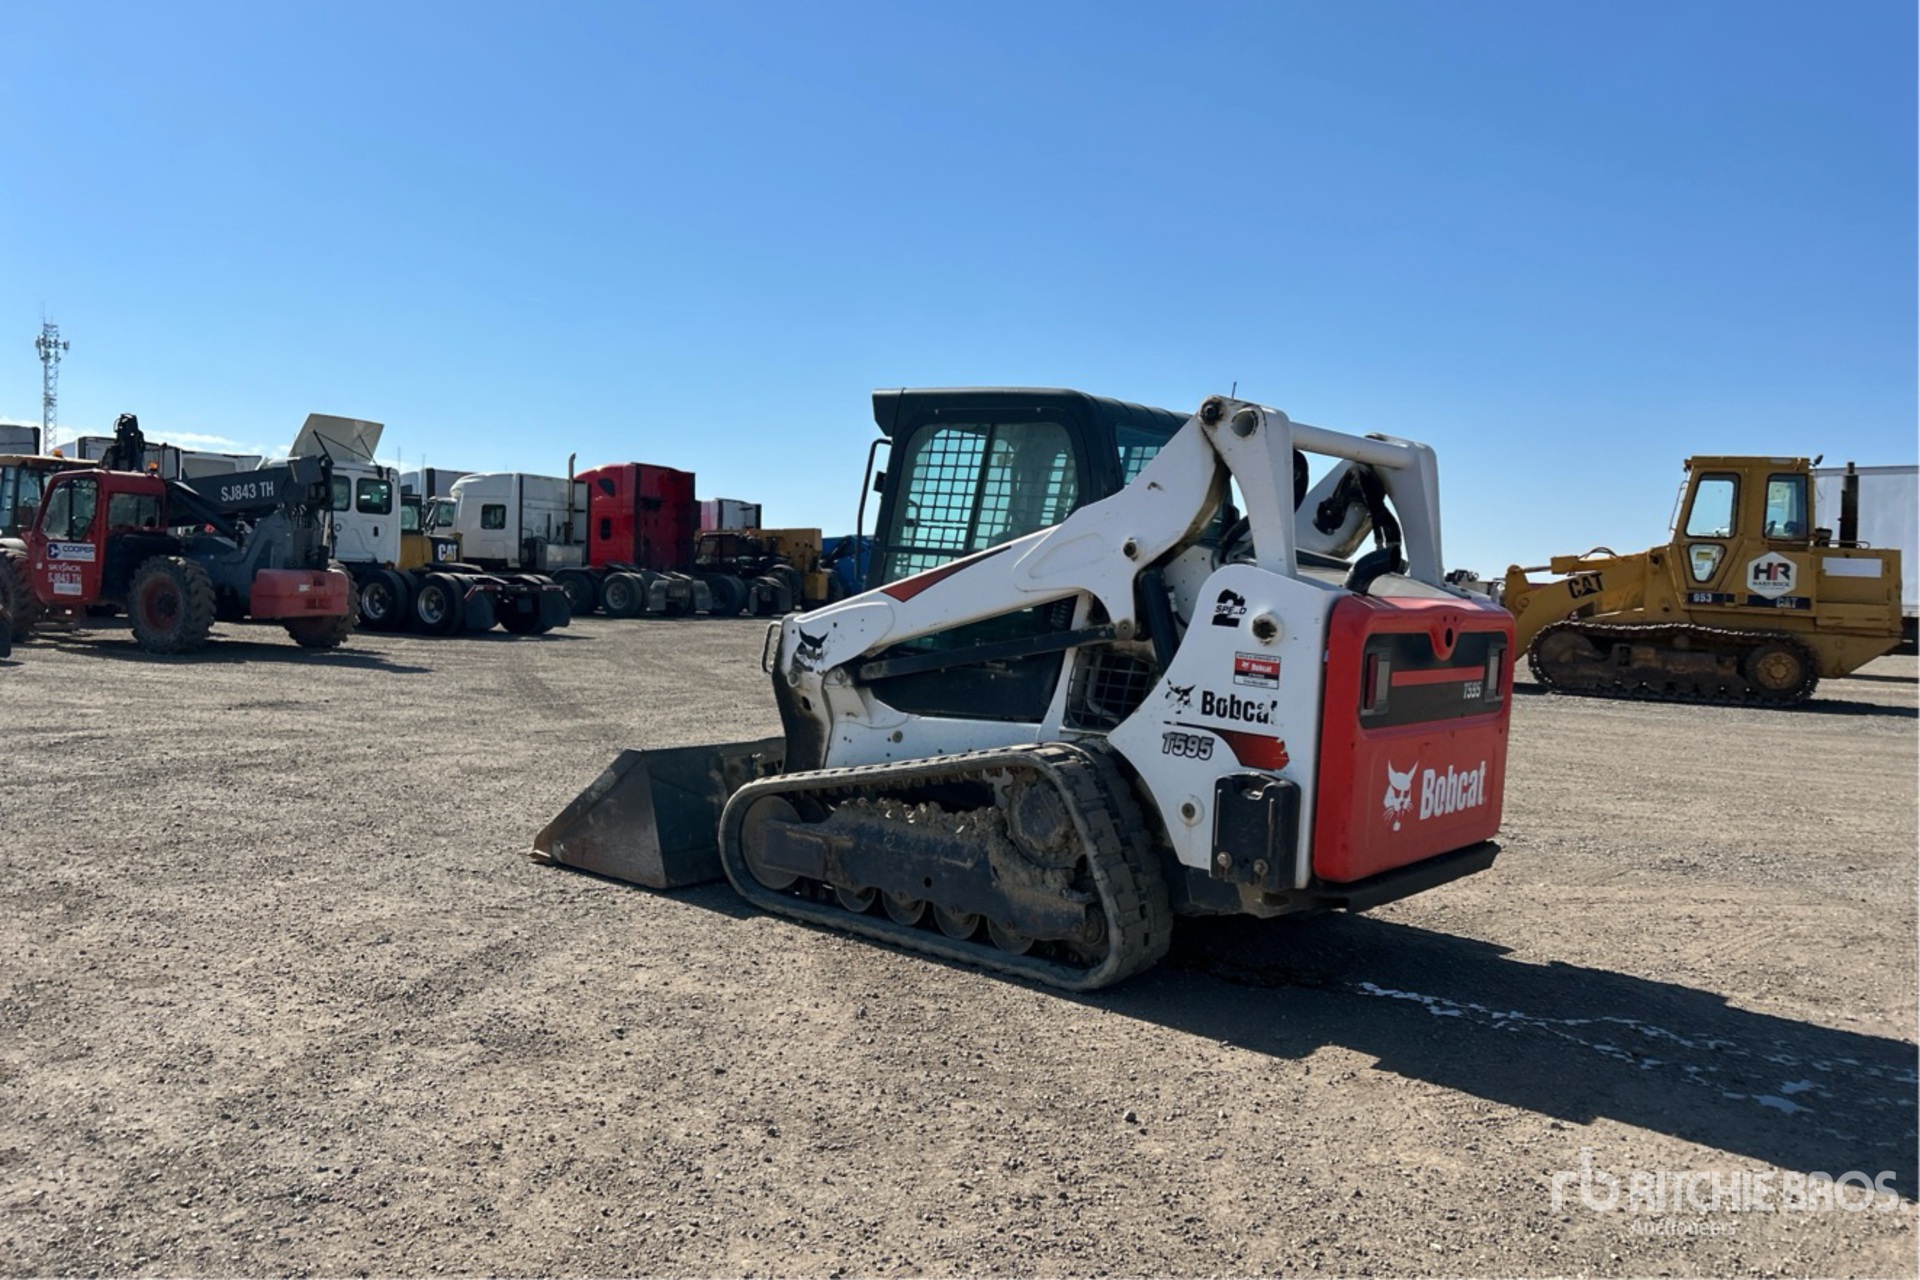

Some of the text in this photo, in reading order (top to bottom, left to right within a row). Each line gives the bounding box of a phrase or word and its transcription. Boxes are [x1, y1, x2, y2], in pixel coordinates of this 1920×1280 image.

[221, 481, 275, 501] SJ843 TH
[437, 543, 458, 561] CAT
[1753, 561, 1791, 581] HR
[1568, 572, 1604, 599] CAT
[1693, 593, 1713, 603] 953
[1776, 597, 1798, 609] CAT
[1215, 603, 1247, 615] SPED
[1463, 681, 1482, 699] T595
[1162, 731, 1215, 761] T595
[1419, 760, 1486, 821] Bobcat
